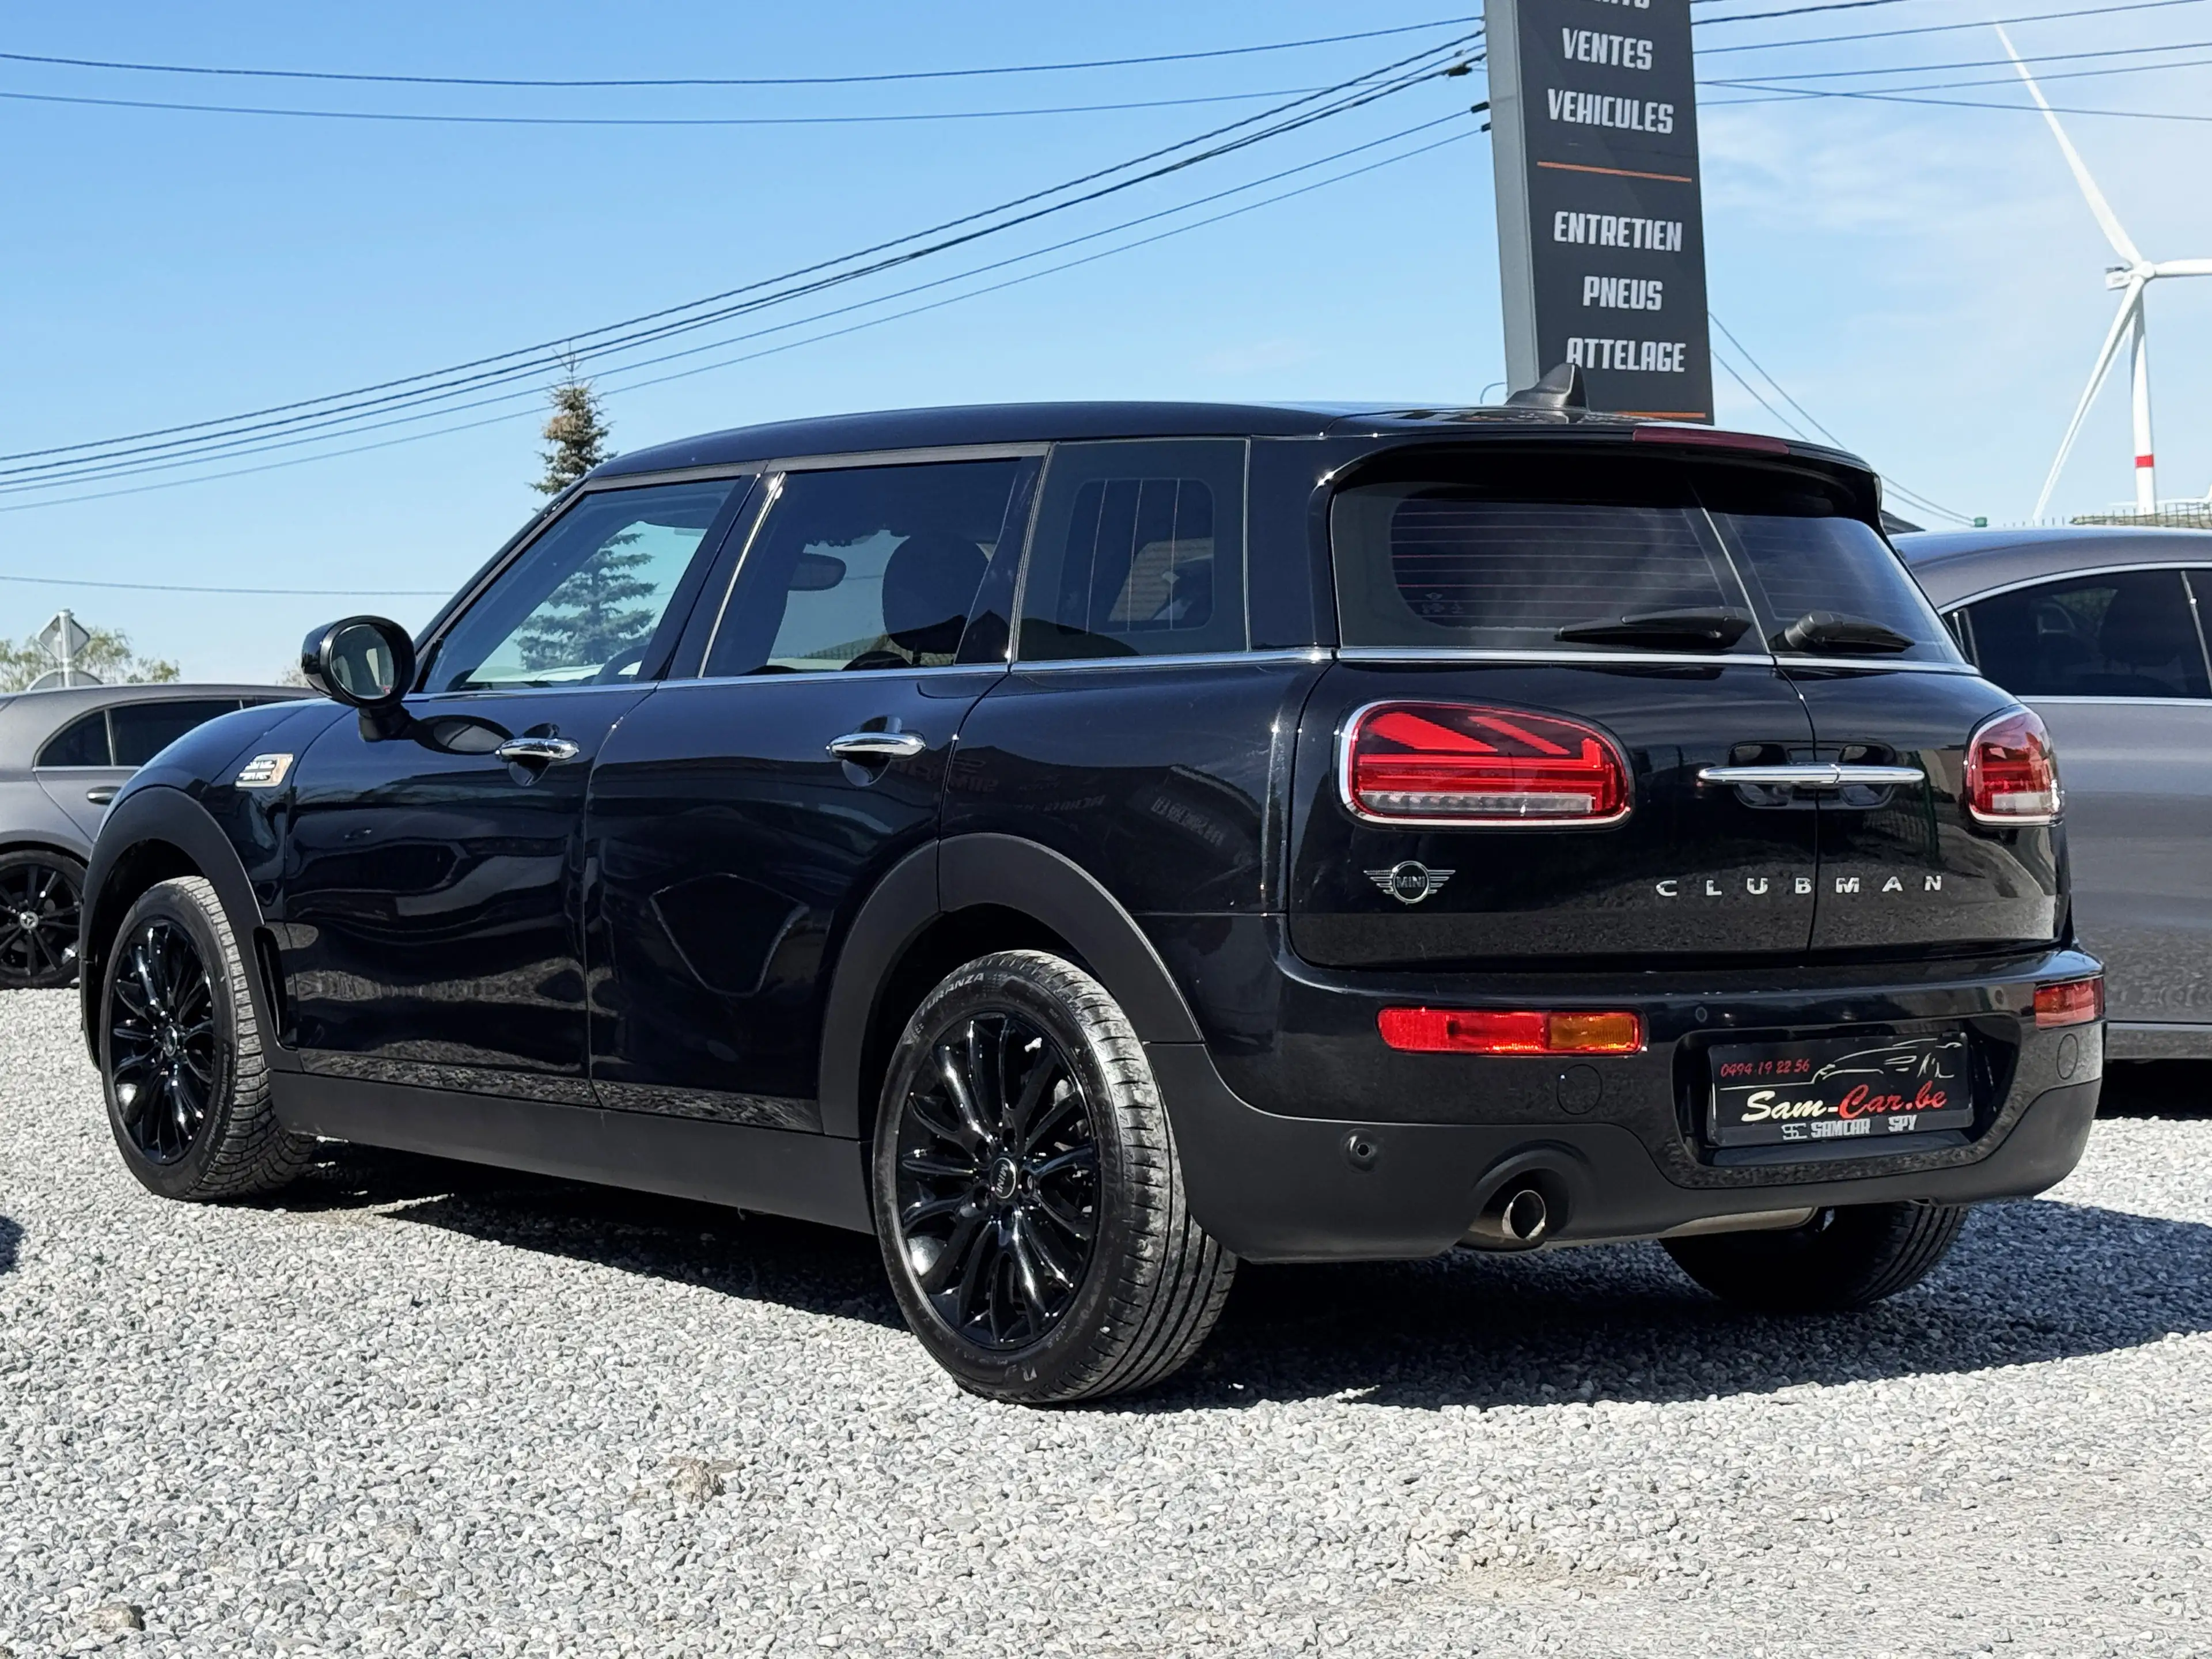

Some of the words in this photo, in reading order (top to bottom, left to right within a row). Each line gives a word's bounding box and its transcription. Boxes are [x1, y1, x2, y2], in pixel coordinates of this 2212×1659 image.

[1562, 28, 1653, 70] VENTES
[1547, 88, 1673, 134] VEHICULES
[1554, 211, 1682, 252] ENTRETIEN
[1583, 276, 1663, 311] PNEUS
[1566, 337, 1686, 373] ATTELAGE
[1396, 876, 1426, 888] MINI
[1656, 875, 1942, 897] CLUBMAN
[1720, 1063, 1753, 1078] 0494
[1758, 1060, 1773, 1076] 19
[1776, 1059, 1792, 1075] 22
[1794, 1058, 1810, 1073] 56
[1741, 1080, 1948, 1123] Sam-Car.be
[1810, 1118, 1871, 1138] SAMCAR
[1888, 1114, 1917, 1132] SPY
[996, 1163, 1009, 1194] MINI
